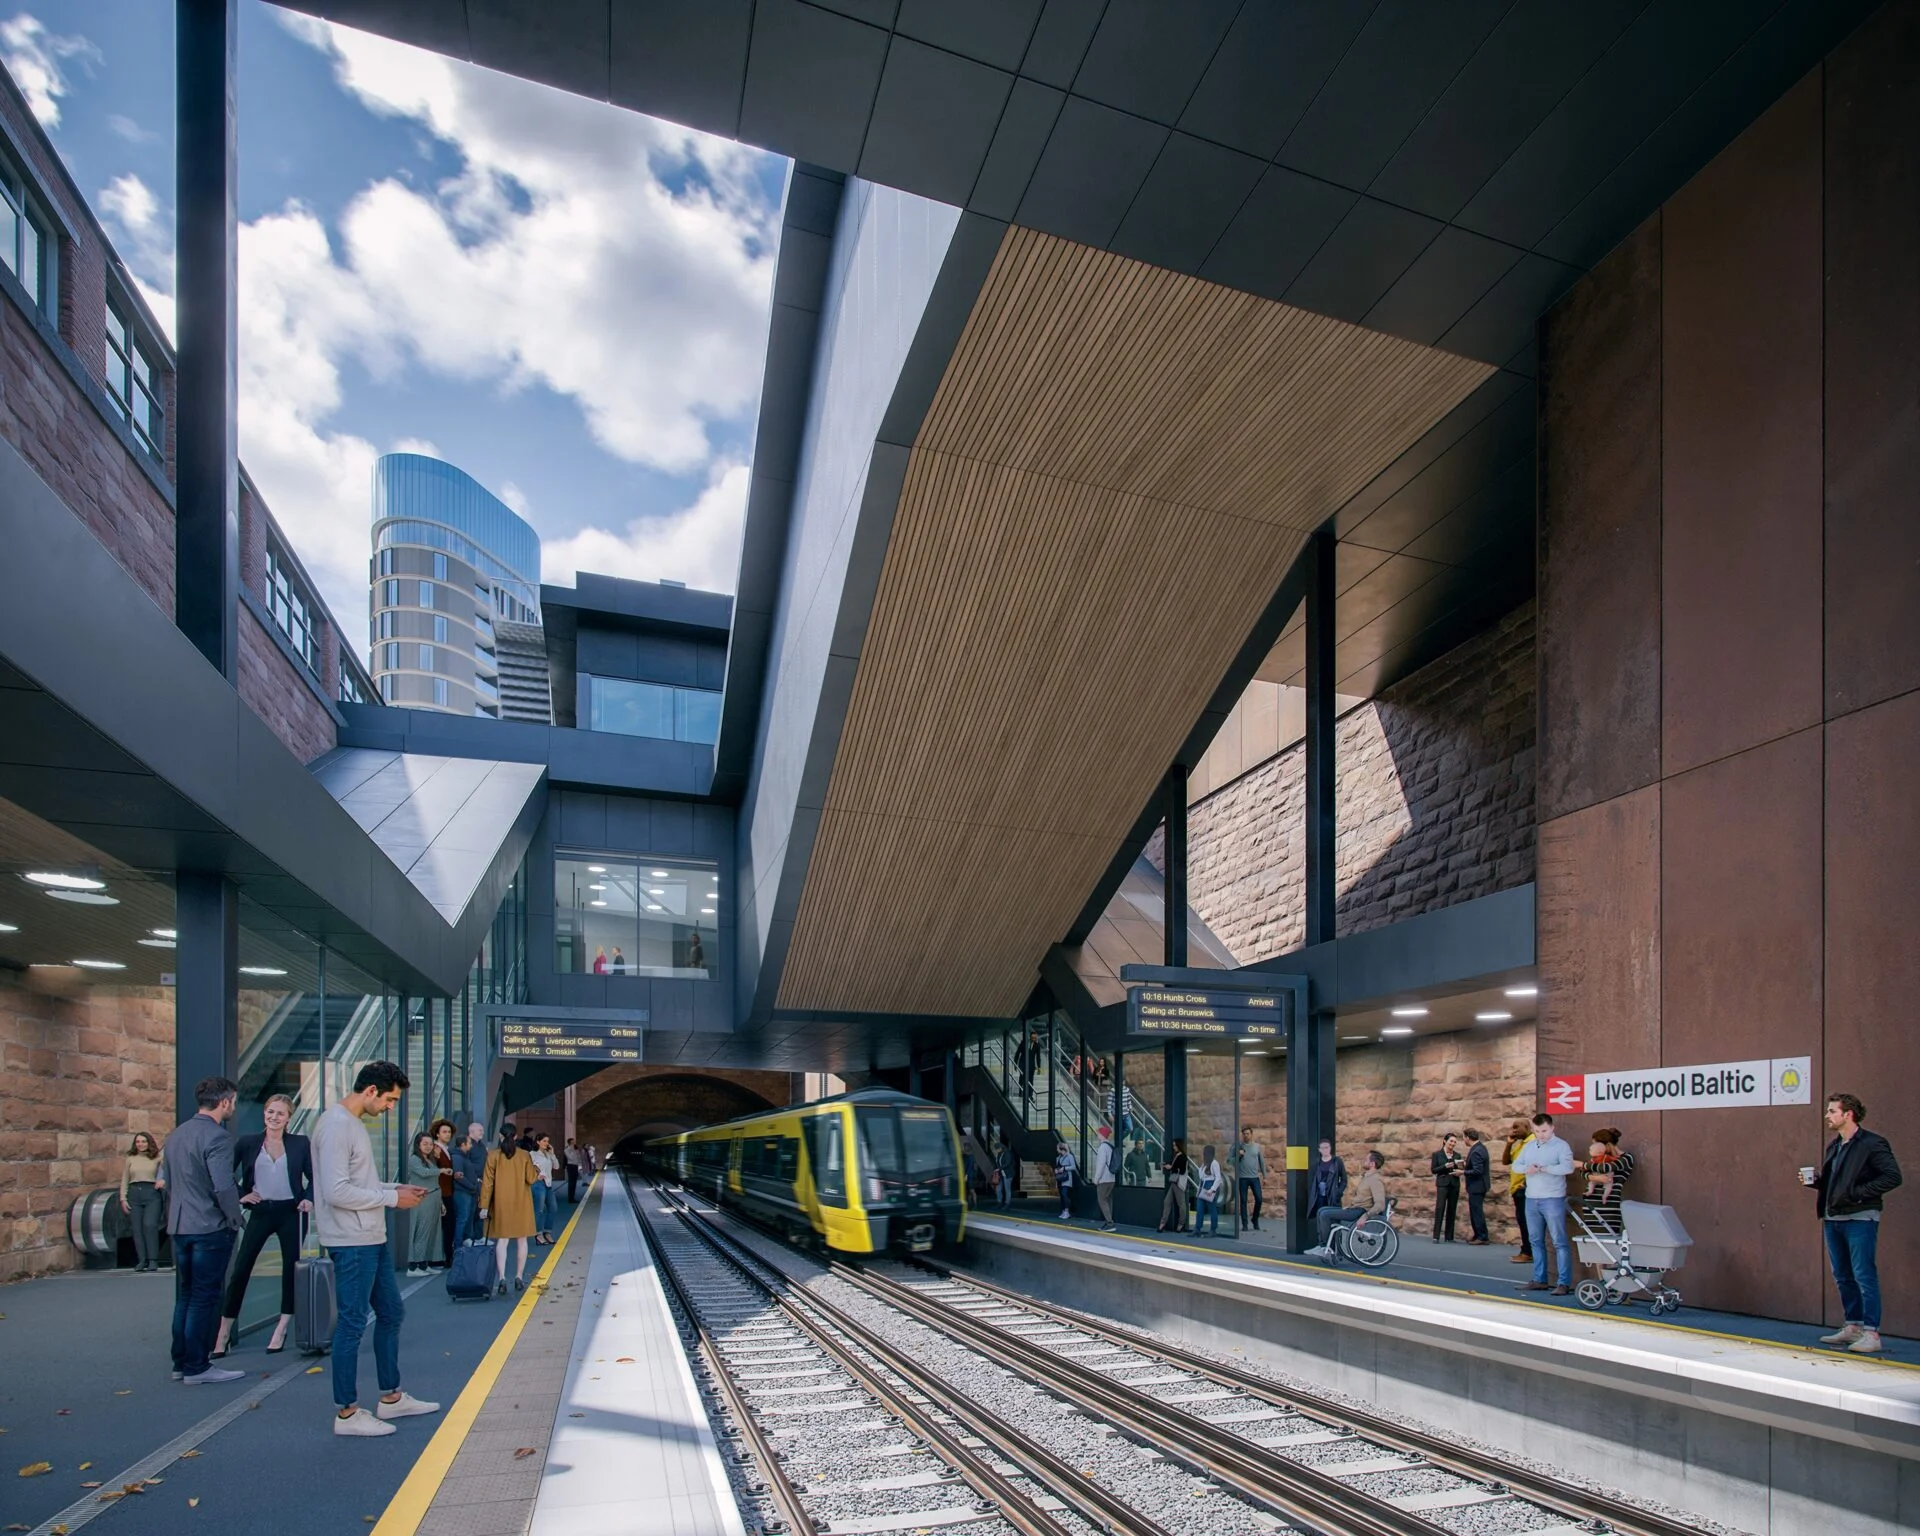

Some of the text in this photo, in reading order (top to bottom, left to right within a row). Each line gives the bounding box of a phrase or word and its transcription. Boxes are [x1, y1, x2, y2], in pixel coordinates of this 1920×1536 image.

[1142, 992, 1274, 1007] 10:16 Hunts Cross Arrived
[1141, 1006, 1214, 1017] Calling at: Brunswick
[503, 1025, 638, 1037] 10:22 Southport On time
[1141, 1020, 1276, 1034] Next 10:36 Hunts Cross On time
[503, 1035, 527, 1045] Calling
[545, 1037, 576, 1046] Liverpool
[577, 1038, 603, 1046] Central
[503, 1047, 638, 1058] Next 10:42 Ormskirk On time
[1594, 1068, 1756, 1104] Liverpool Baltic
